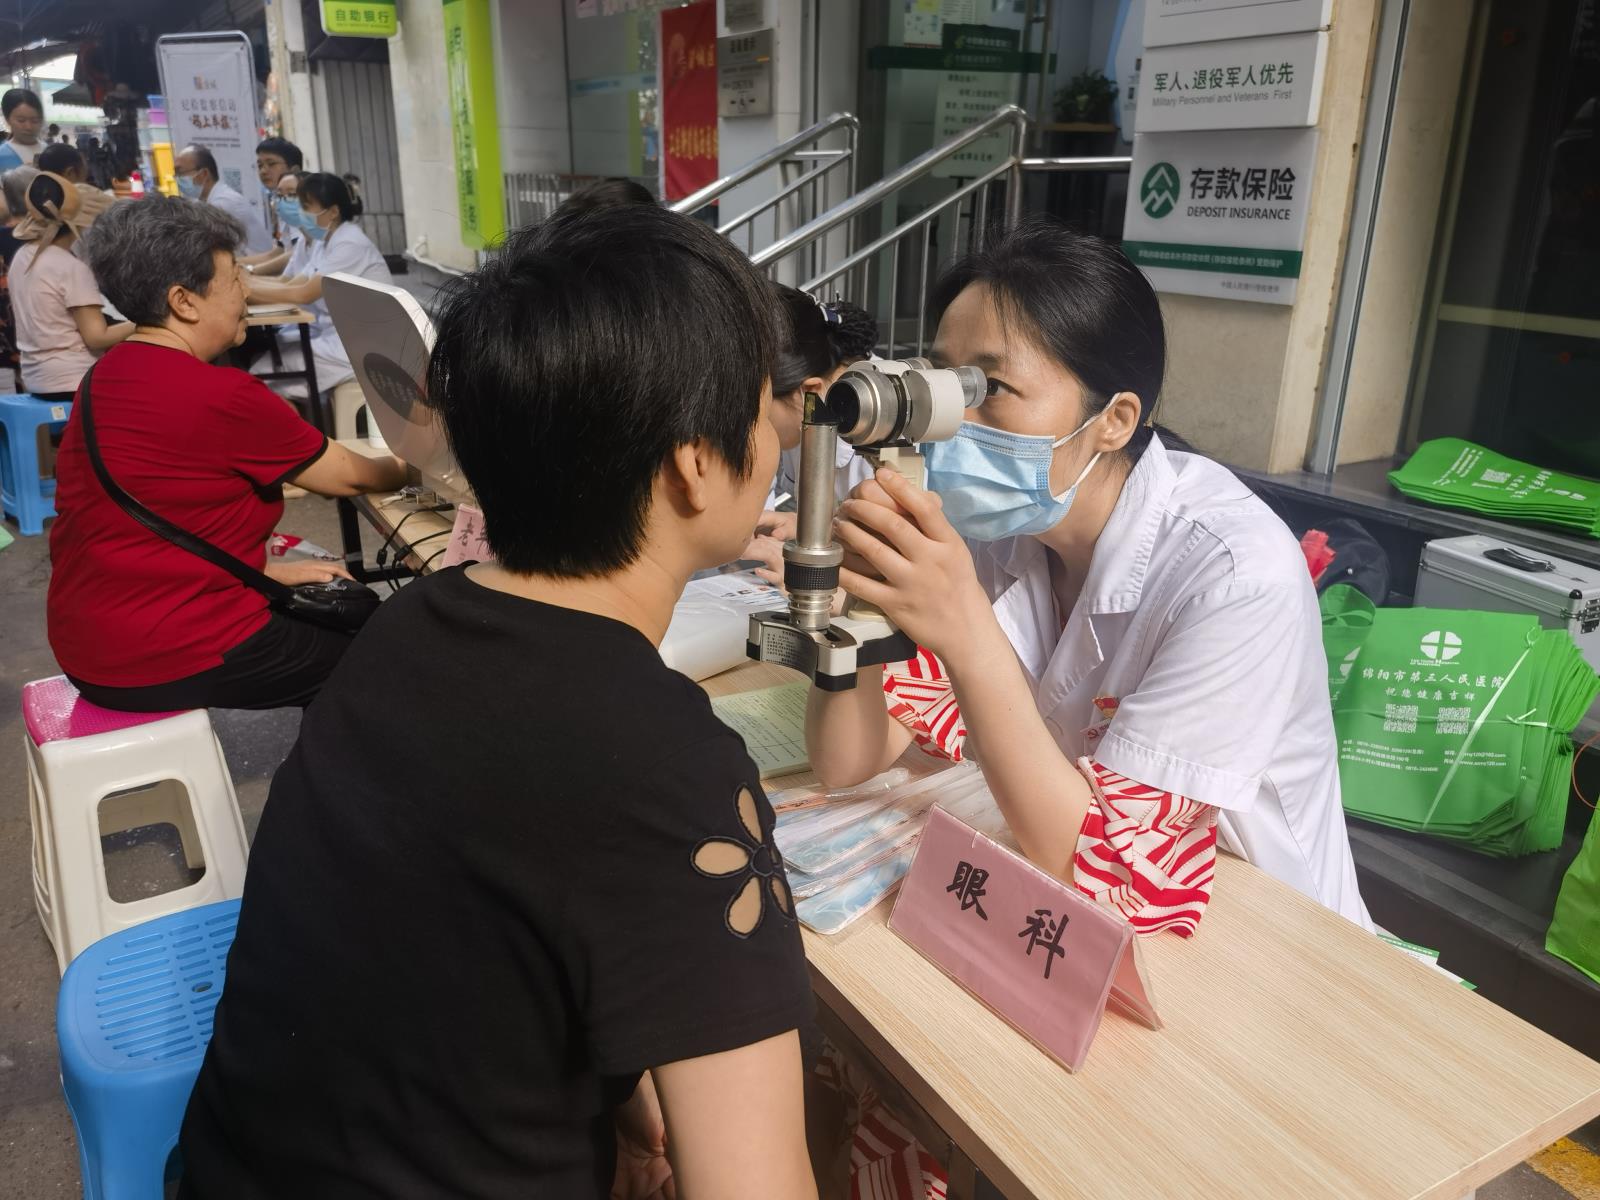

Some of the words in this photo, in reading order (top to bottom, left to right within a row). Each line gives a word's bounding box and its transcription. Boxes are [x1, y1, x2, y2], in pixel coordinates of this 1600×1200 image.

[335, 9, 390, 23] 自助银行
[1153, 62, 1295, 92] 军人、退役军人优先
[1152, 97, 1177, 108] Military
[1179, 95, 1216, 105] Personnel
[1217, 94, 1232, 103] and
[1234, 91, 1269, 102] Veterans
[1273, 90, 1293, 100] First
[1190, 167, 1296, 201] 存款保险
[1187, 206, 1228, 218] DEPOSIT
[1229, 207, 1291, 220] INSURANCE
[1362, 667, 1505, 689] 绵阳市第三人民医院
[946, 861, 1069, 979] 眼科
